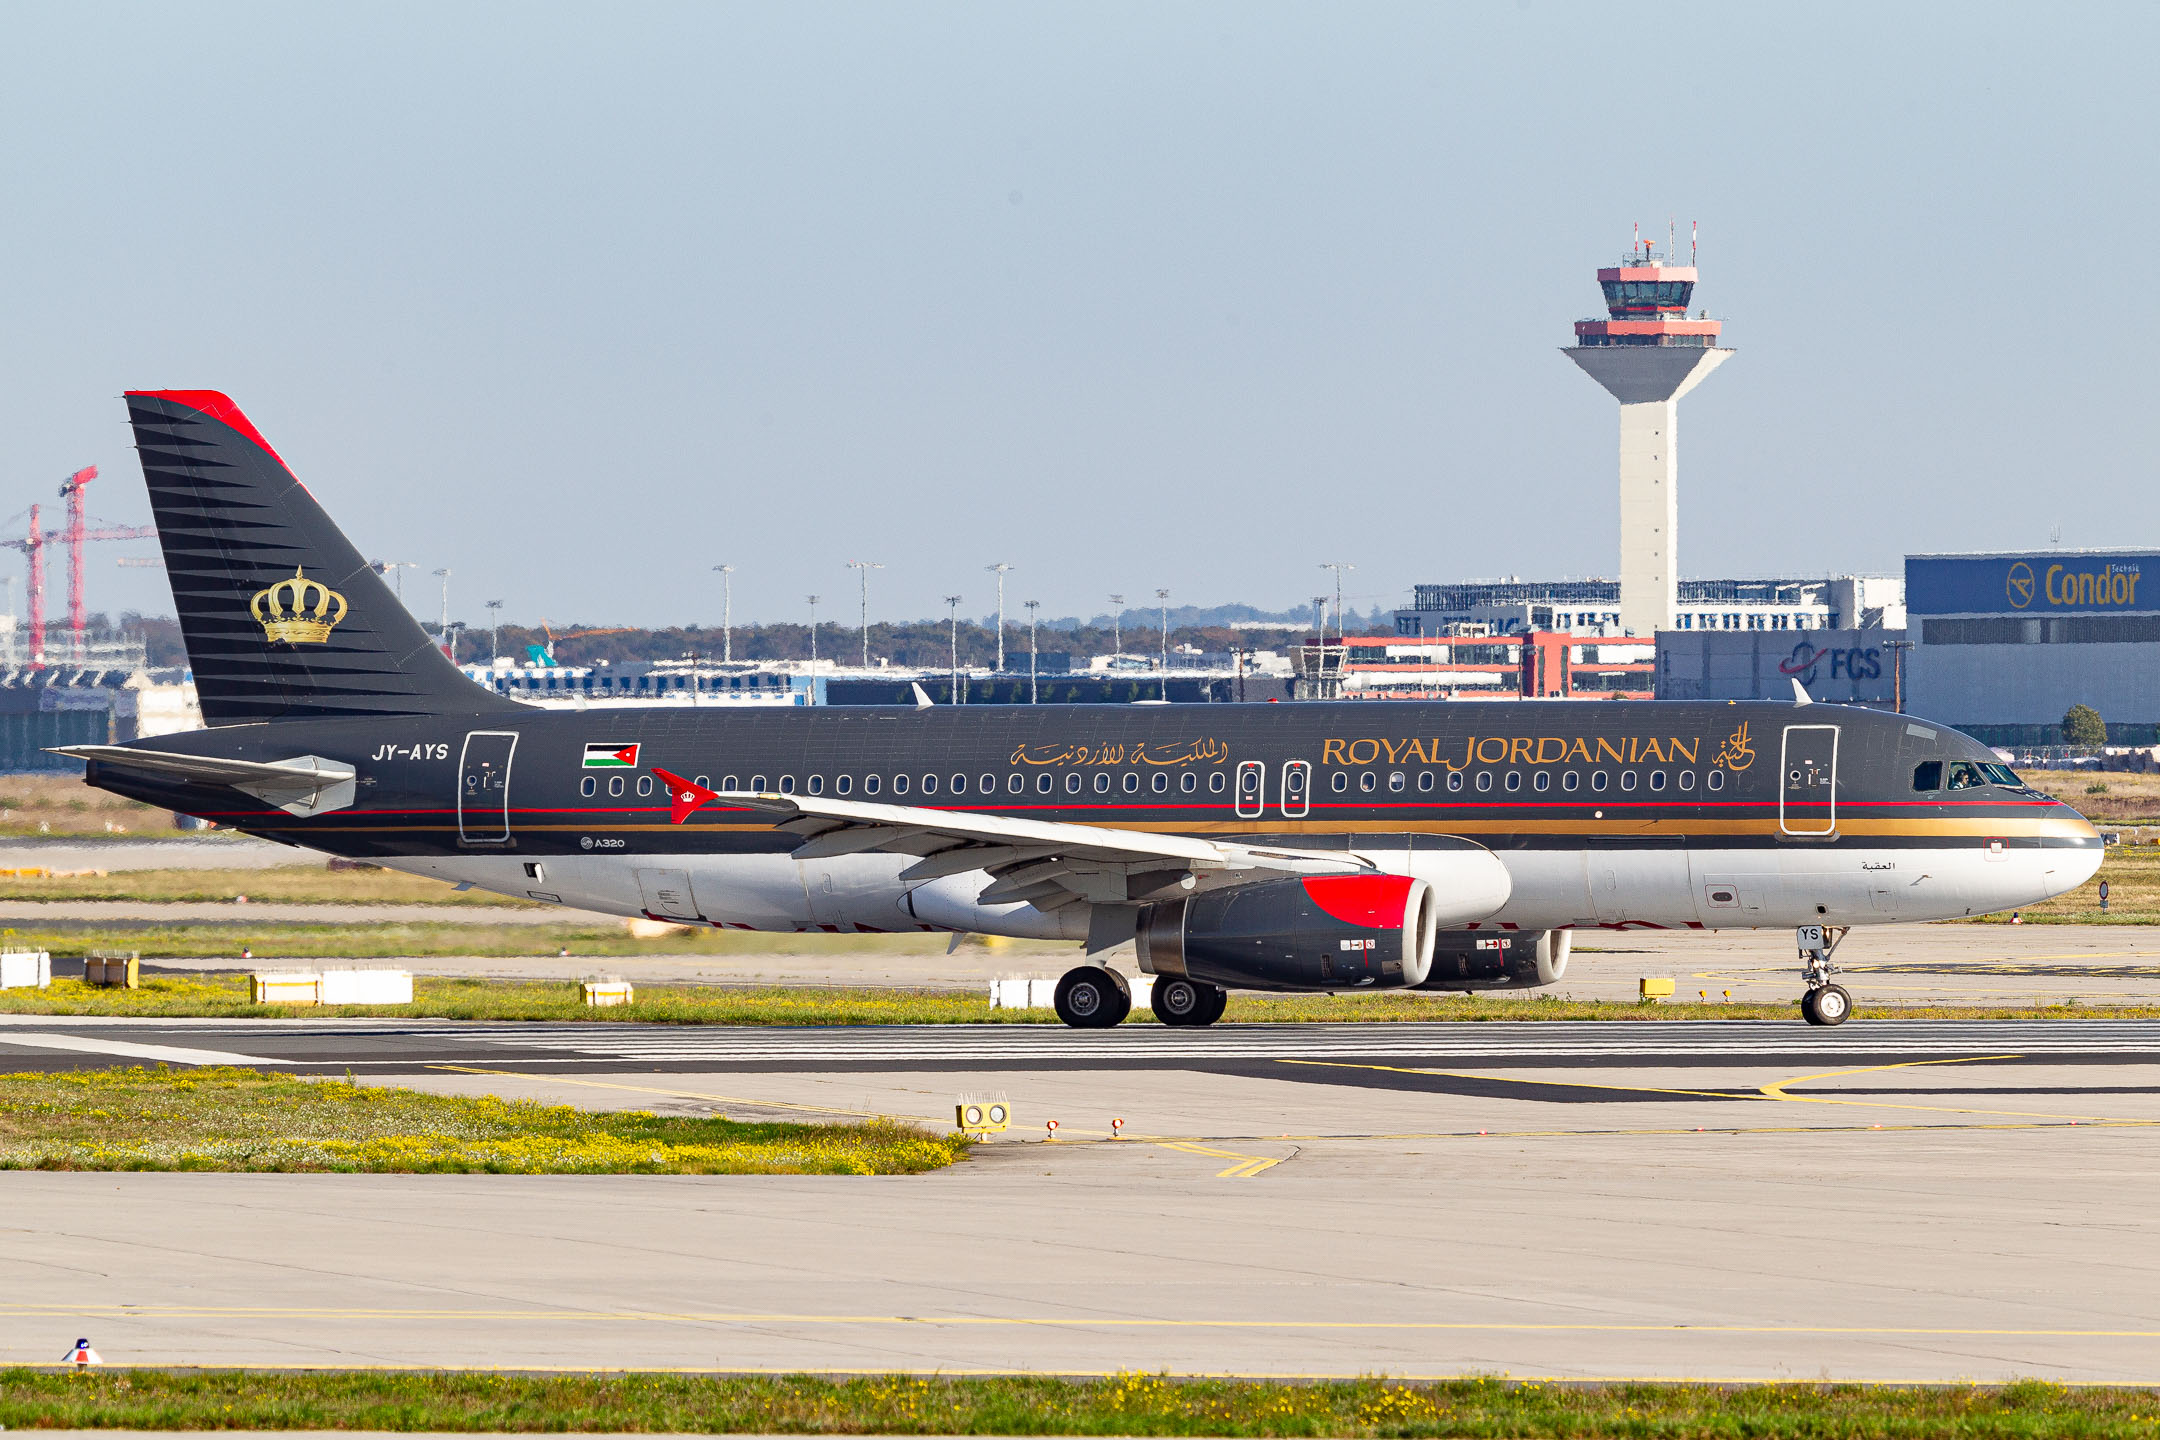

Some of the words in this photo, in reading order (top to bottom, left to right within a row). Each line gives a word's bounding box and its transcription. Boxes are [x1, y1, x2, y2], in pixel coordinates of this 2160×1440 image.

[2046, 564, 2141, 605] Condor
[1831, 647, 1881, 680] FCS
[372, 743, 449, 761] JY-AYS
[1322, 737, 1450, 765] ROYAL
[1446, 736, 1700, 771] JORDANIAN
[594, 838, 625, 848] A320
[1861, 861, 1896, 873] العقبة
[1801, 928, 1819, 941] YS
